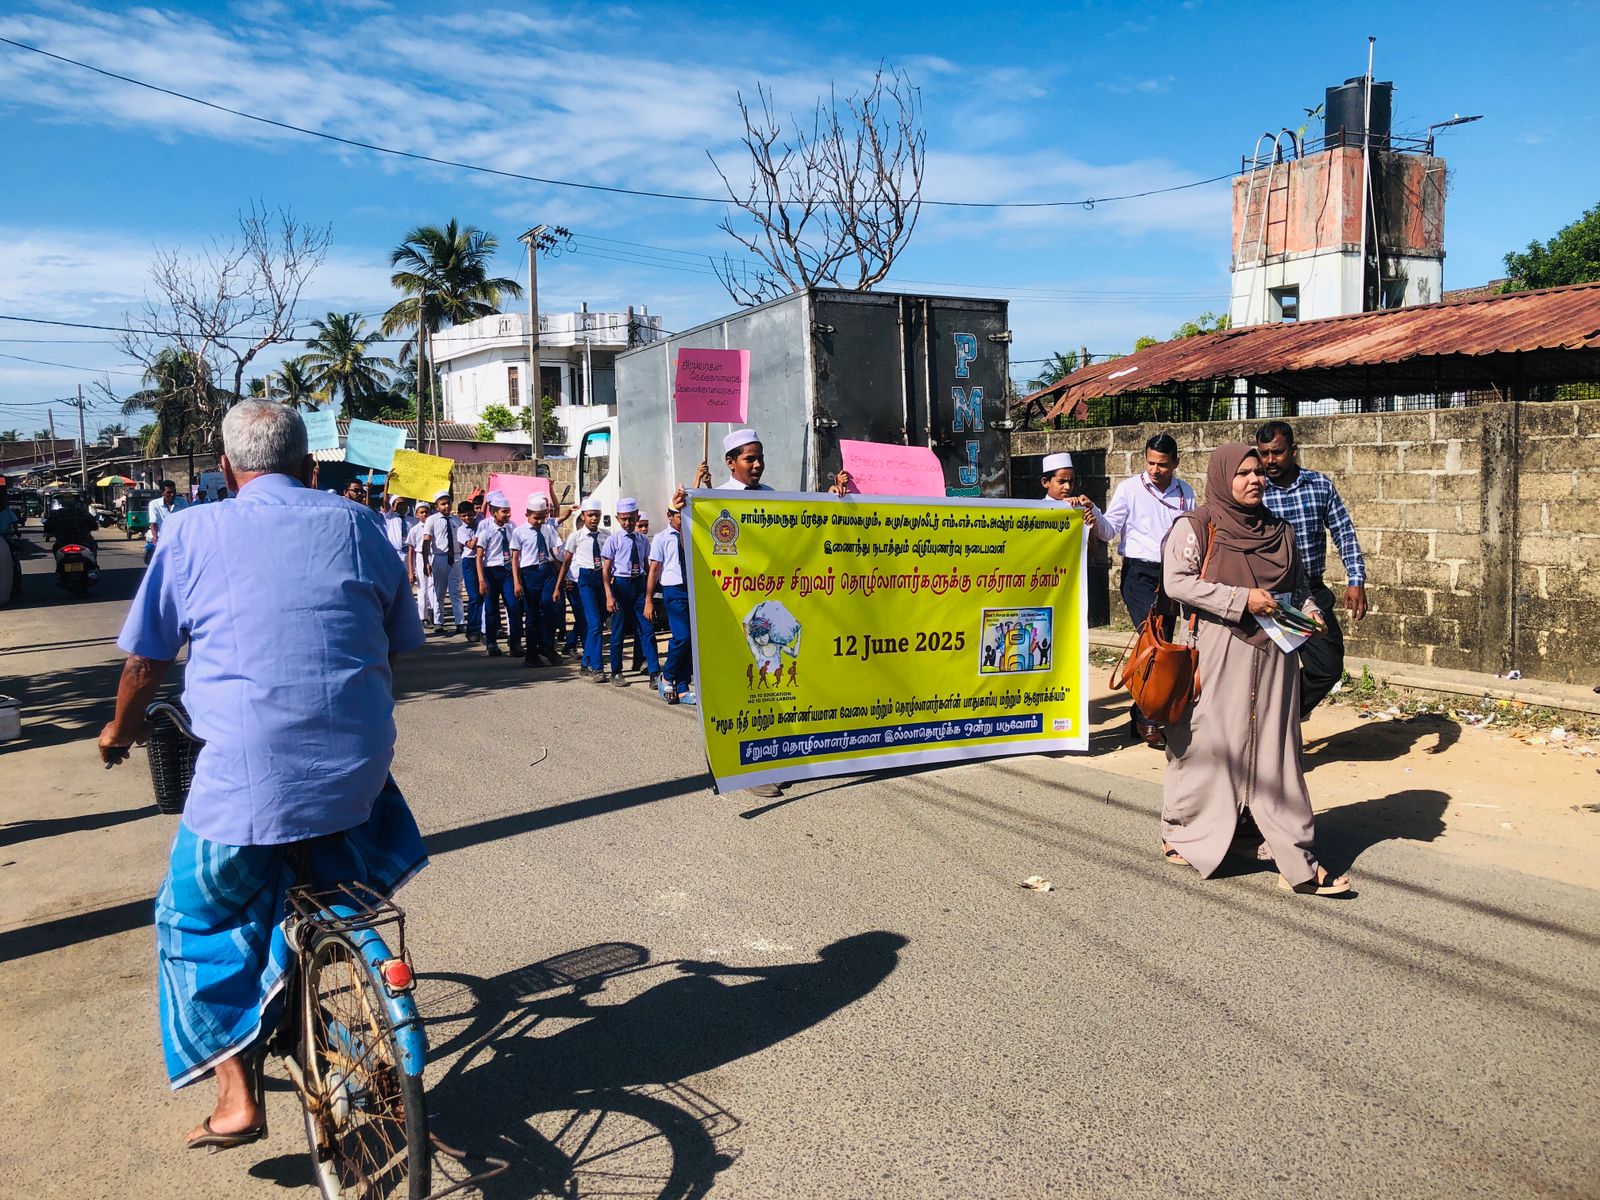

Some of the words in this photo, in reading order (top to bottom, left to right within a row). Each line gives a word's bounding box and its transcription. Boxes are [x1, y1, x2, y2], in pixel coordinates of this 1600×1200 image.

[741, 508, 798, 528] சாய்ந்தமருது
[801, 510, 829, 528] பிரதேச
[1016, 515, 1071, 532] வித்தியாலயமும்
[824, 538, 870, 557] இணைந்து
[872, 538, 909, 557] நடாத்தும்
[912, 538, 962, 558] விழிப்புணர்வு
[964, 540, 1006, 558] நடைபவனி
[790, 566, 836, 598] சிறுவர்
[841, 566, 971, 597] தொழிலாளர்களுக்கு
[976, 567, 1026, 593] எதிரான
[833, 635, 858, 656] 12
[861, 634, 909, 661] June
[915, 631, 965, 652] 2025
[736, 709, 750, 735] நீதி
[752, 706, 775, 732] மற்றும்
[777, 705, 838, 724] கண்ணியமான
[840, 706, 868, 719] வேலை
[870, 697, 893, 720] மற்றும்
[895, 693, 961, 717] தொழிலாளர்களின்
[963, 690, 997, 711] பாதுகாப்பு
[1000, 688, 1021, 709] மற்றும்
[745, 739, 779, 761] சிறுவர்
[782, 732, 881, 755] தொழிலாளர்களை
[884, 722, 961, 742] இல்லாதொழிக்க
[964, 719, 993, 736] ஒன்று
[996, 715, 1038, 732] படுவோம்
